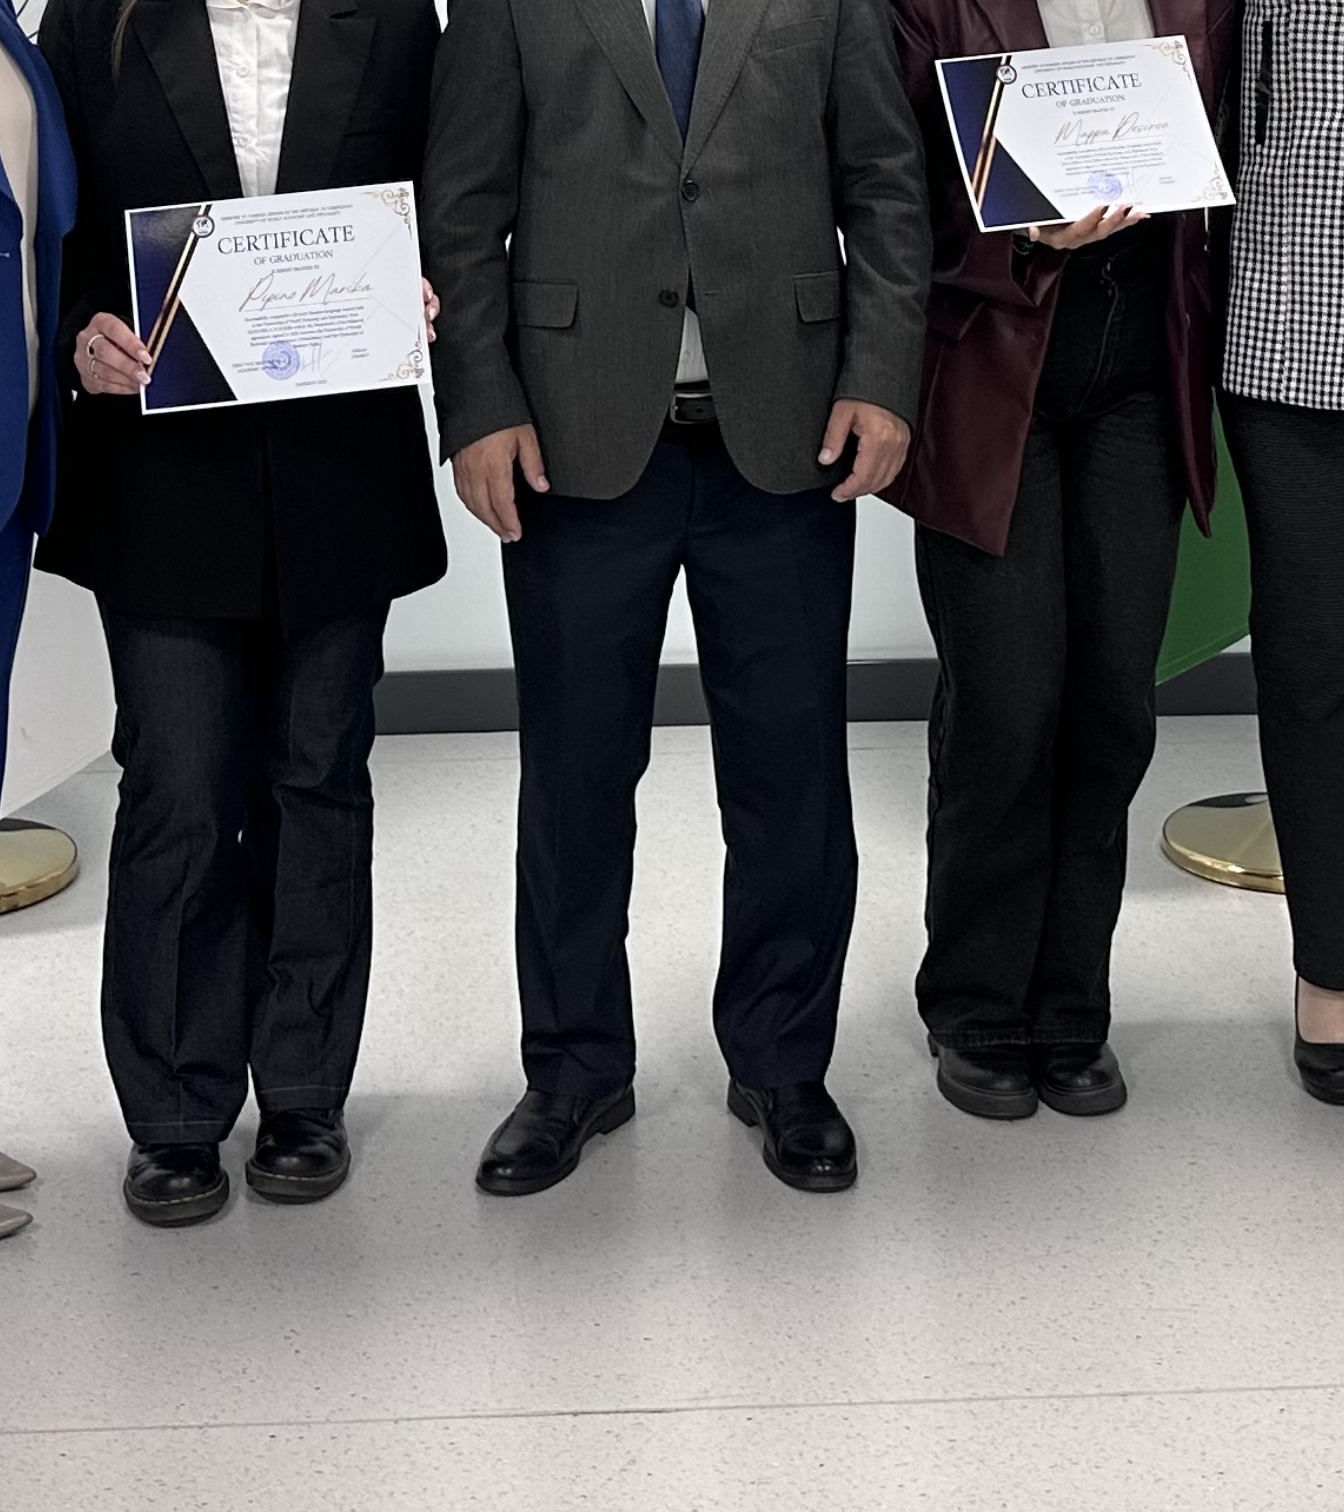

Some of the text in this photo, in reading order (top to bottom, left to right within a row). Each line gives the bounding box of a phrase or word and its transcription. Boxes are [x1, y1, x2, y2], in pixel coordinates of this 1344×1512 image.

[1021, 72, 1142, 99] CERTIFICATE
[1055, 94, 1126, 108] OF GRADUATION
[218, 224, 355, 255] CERTIFICATE
[253, 249, 334, 266] OF GRADUATION
